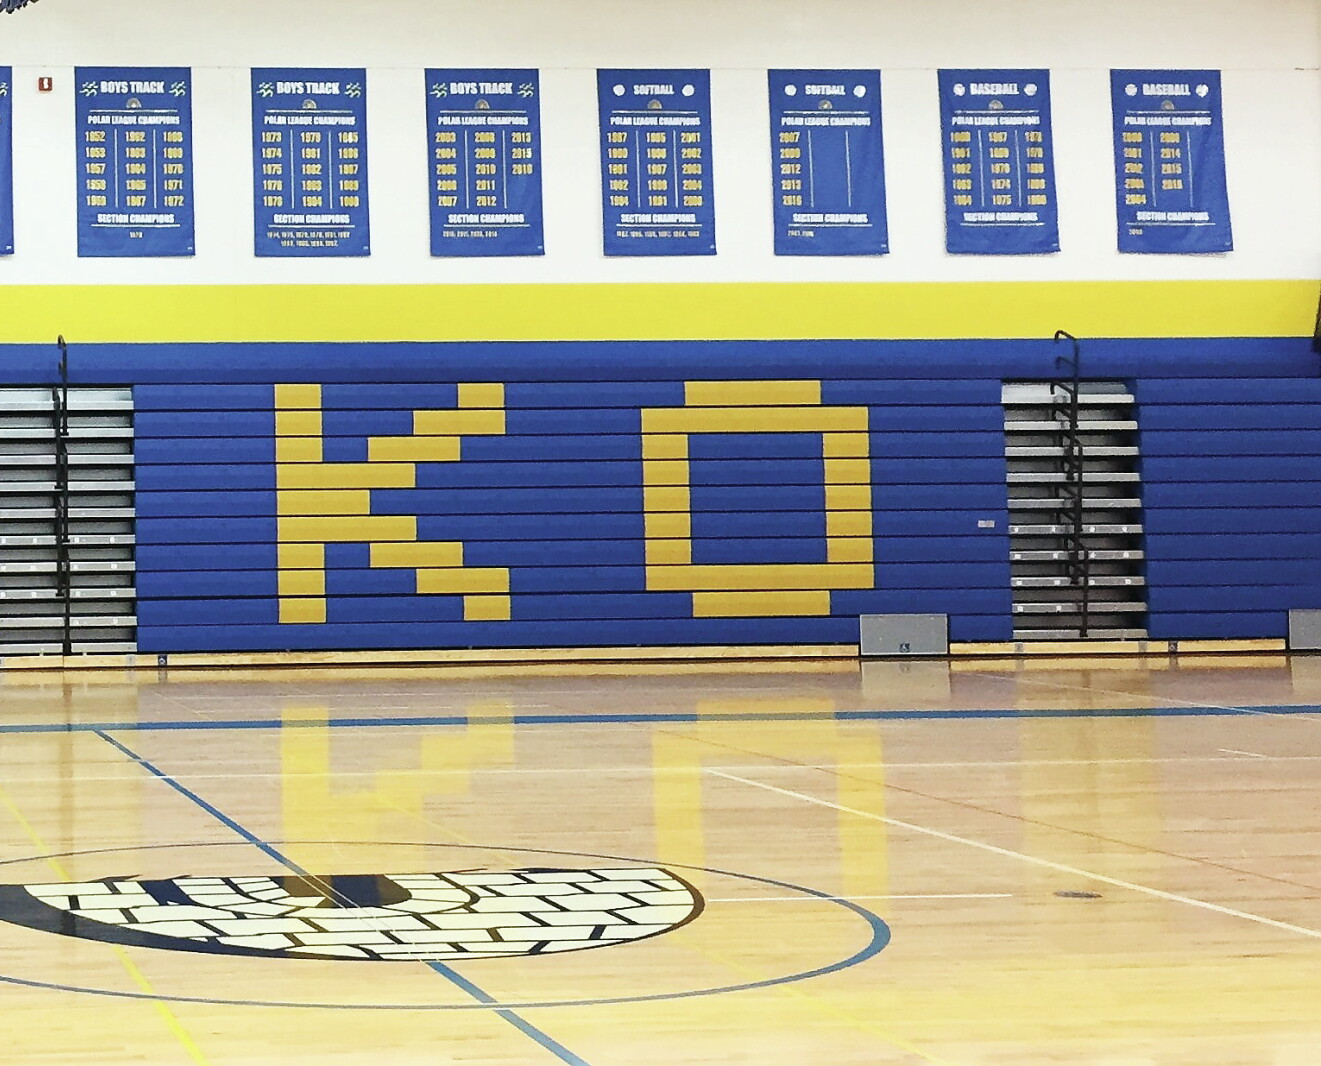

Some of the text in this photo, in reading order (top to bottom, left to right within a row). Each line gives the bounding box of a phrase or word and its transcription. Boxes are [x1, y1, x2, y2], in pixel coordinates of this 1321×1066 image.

[101, 81, 165, 94] BOYS TRACK
[277, 82, 341, 94] BOYS TRACK
[450, 83, 513, 94] BOYS TRACK
[634, 85, 675, 95] SOFTBALL
[805, 85, 846, 95] SOFTBALL
[970, 83, 1020, 95] BASEBALL
[1143, 84, 1192, 96] BASEBALL
[88, 116, 181, 125] POLAR LEAGUE CHAMPIONS
[264, 116, 356, 126] POLAR LEAGUE CHAMPIONS
[438, 116, 529, 126] POLAR LEAGUE CHAMPIONS
[659, 117, 701, 126] CHAMPIONS
[476, 180, 496, 190] 2011
[477, 196, 497, 206] 2012
[98, 214, 175, 224] SECTION CHAMPIONS
[274, 214, 351, 224] SECTION CHAMPIONS
[448, 214, 525, 223] SECTION CHAMPIONS
[621, 214, 697, 223] SECTION CHAMPIONS
